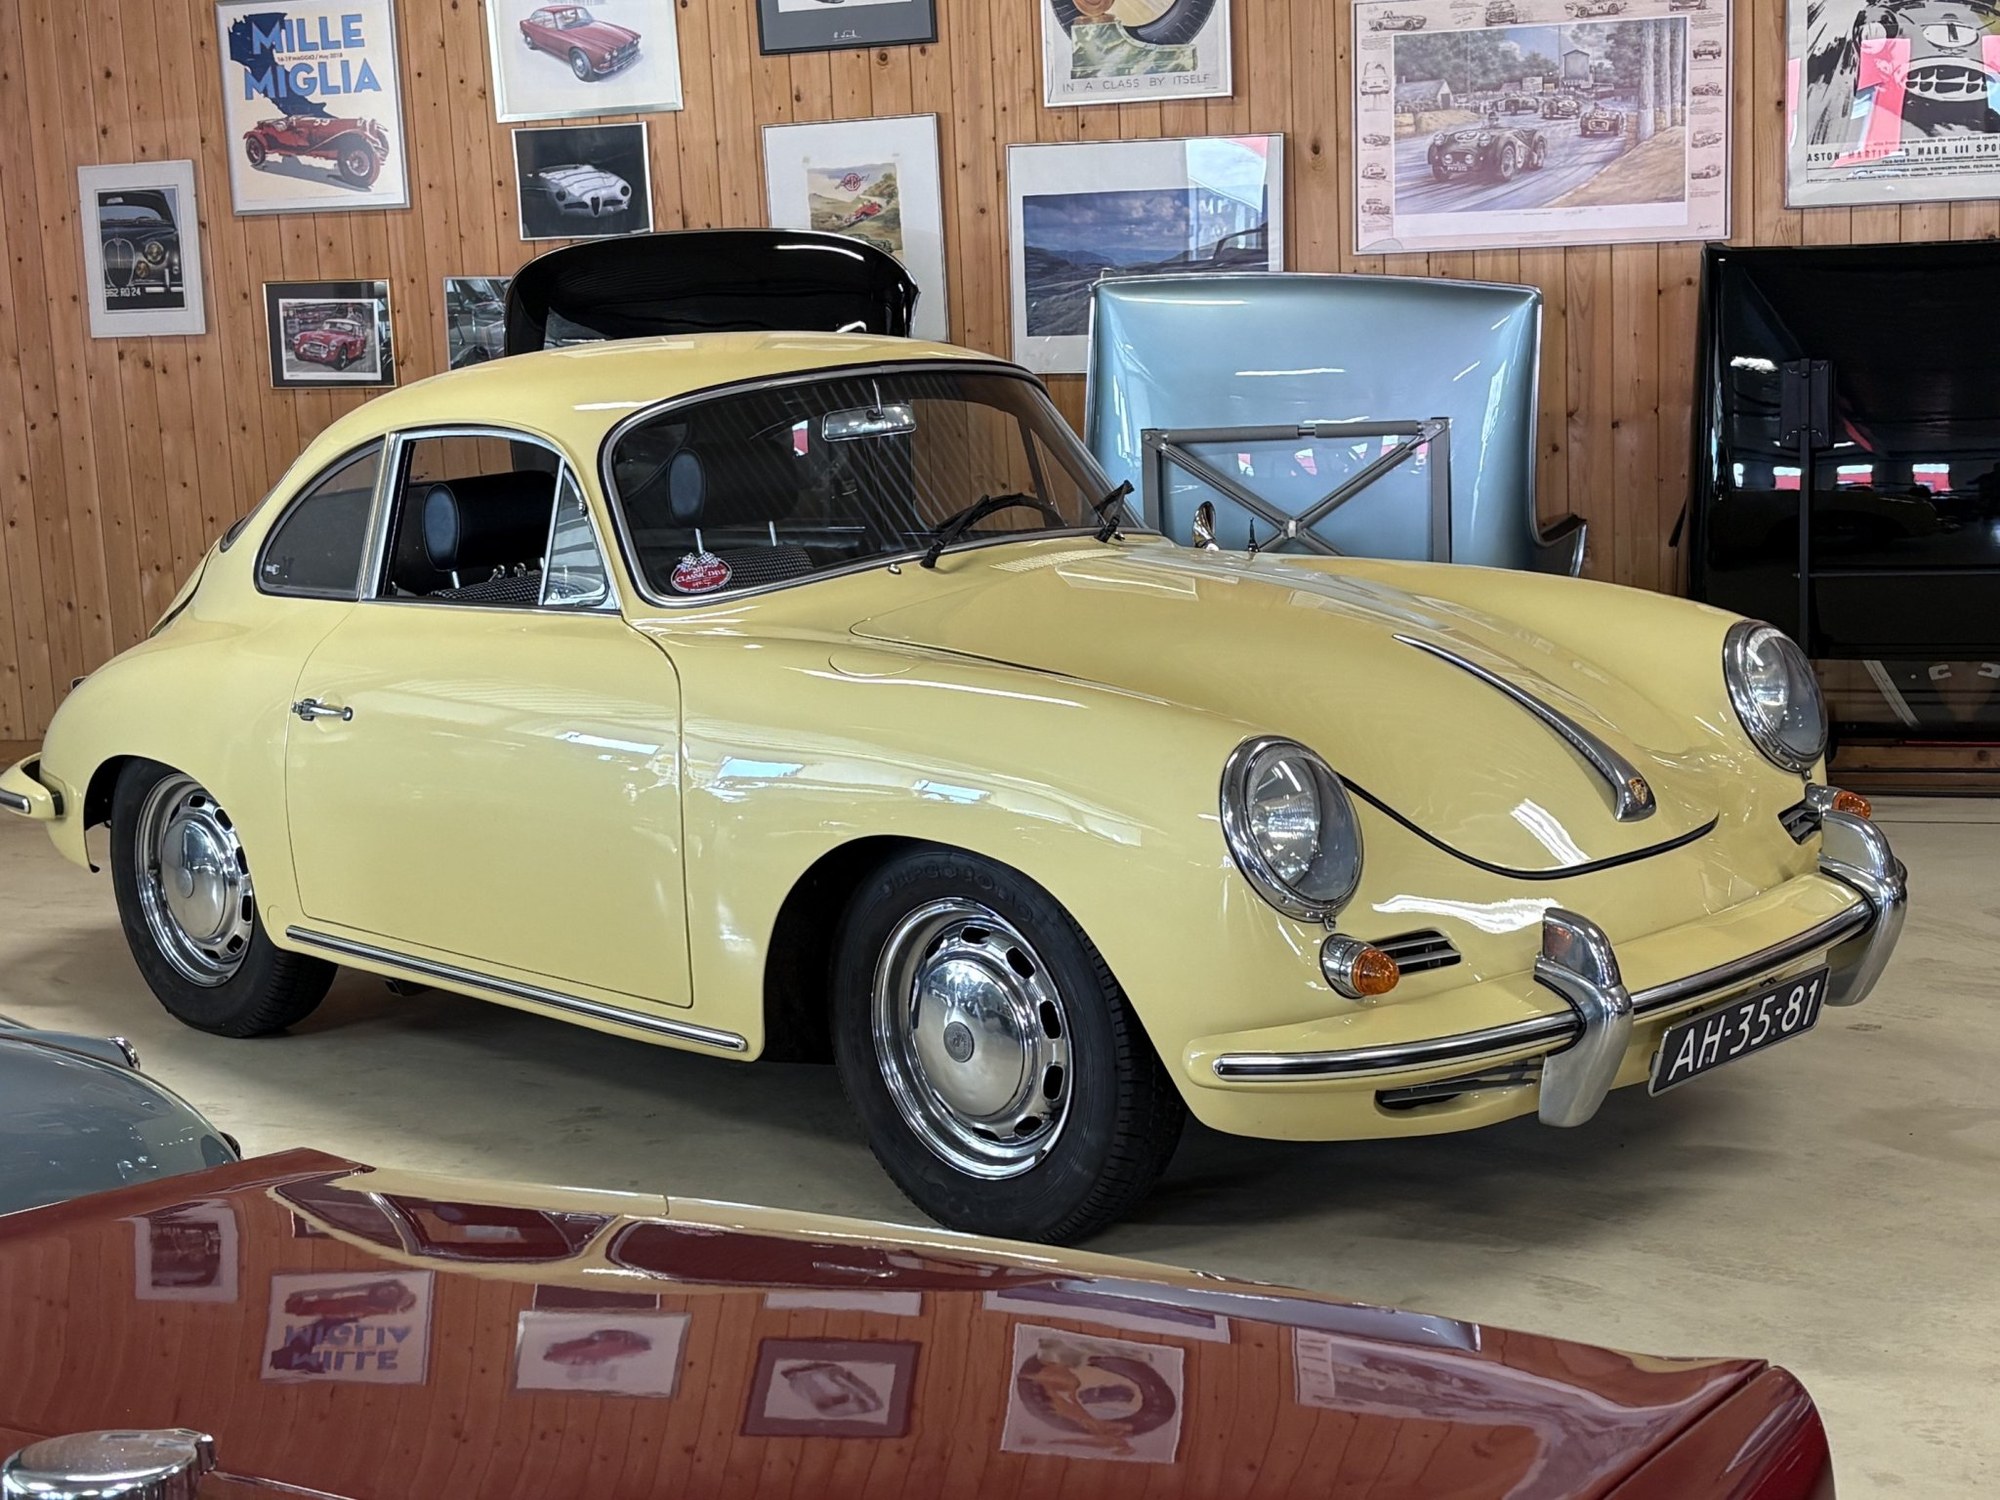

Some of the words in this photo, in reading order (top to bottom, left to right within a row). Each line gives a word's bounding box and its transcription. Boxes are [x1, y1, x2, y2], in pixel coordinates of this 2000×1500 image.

[252, 14, 365, 55] MILLE
[244, 58, 382, 101] MIGLIA
[1062, 83, 1074, 92] IN
[1085, 81, 1093, 90] A
[1102, 78, 1140, 90] CLASS
[1149, 76, 1165, 87] BY
[1173, 73, 1211, 85] ITSELF
[1807, 152, 1840, 162] ASTON
[1848, 150, 1889, 159] MARTIN
[1918, 146, 1947, 155] MARK
[1955, 145, 1968, 154] III
[131, 287, 141, 296] 24
[1667, 979, 1820, 1082] AH-35-81
